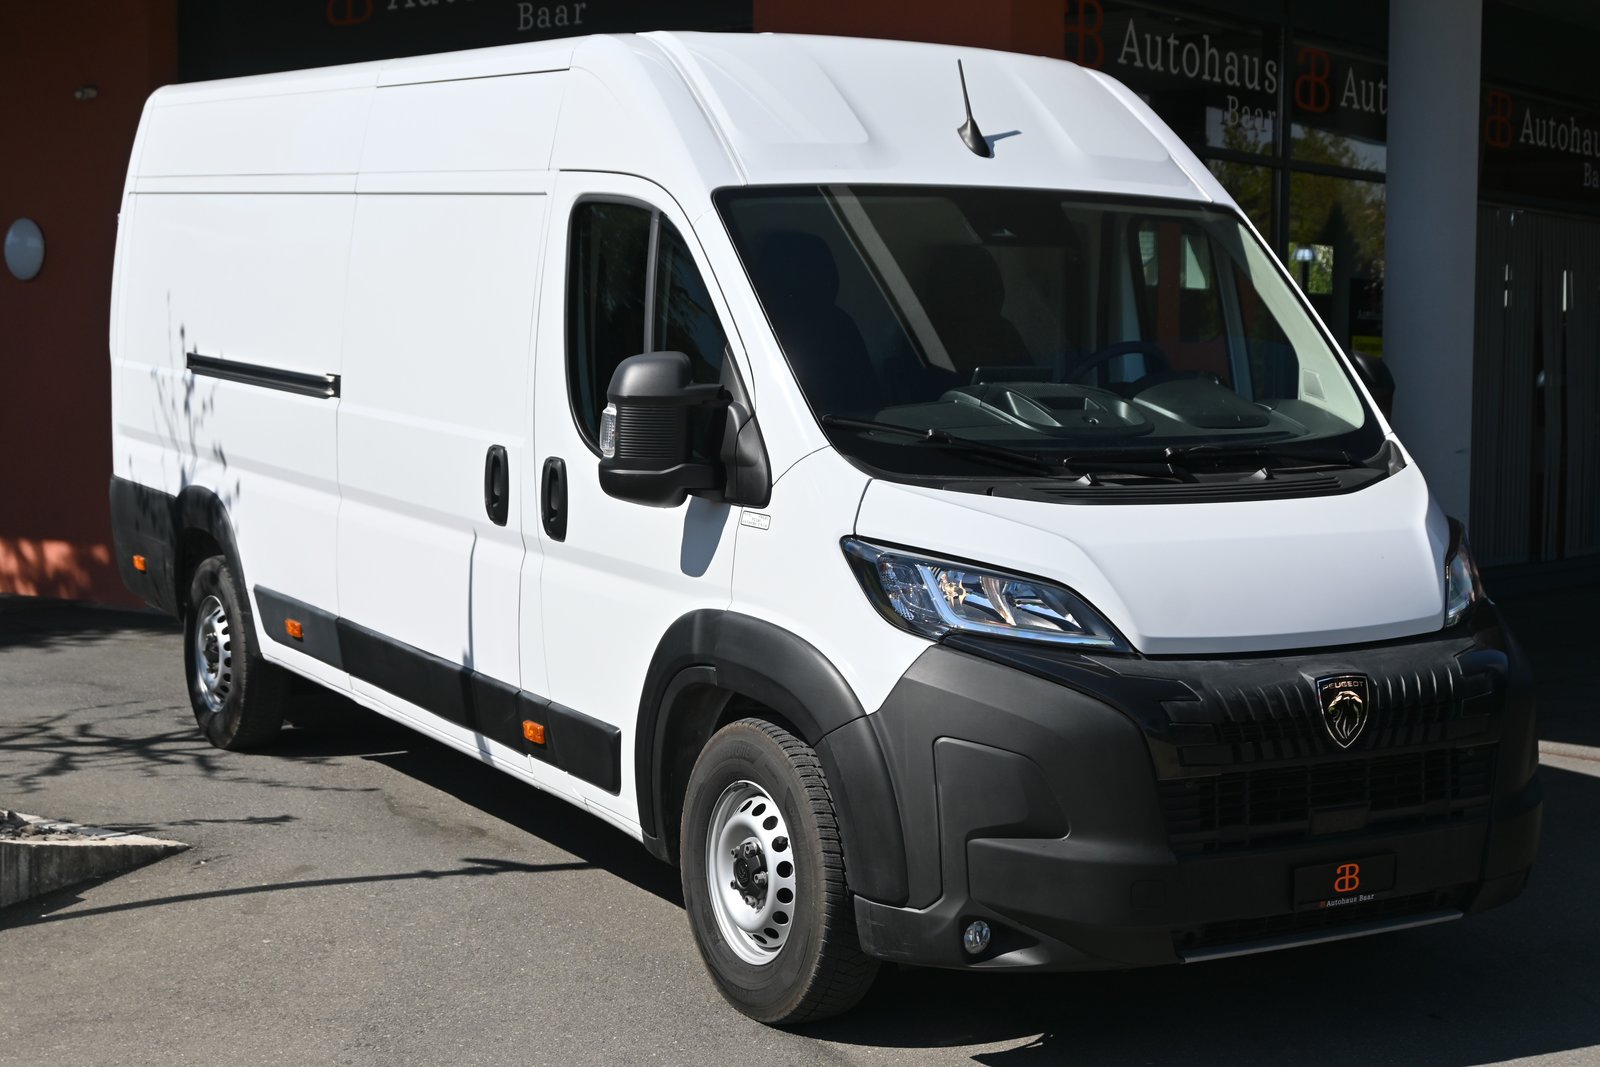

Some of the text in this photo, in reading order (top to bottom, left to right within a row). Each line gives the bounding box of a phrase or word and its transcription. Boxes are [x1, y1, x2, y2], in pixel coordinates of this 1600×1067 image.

[517, 2, 586, 31] Baar
[1117, 18, 1278, 94] Autohaus
[1339, 66, 1388, 115] Aut
[1224, 95, 1277, 131] Baar
[1322, 680, 1364, 690] PEUGEOT
[1326, 897, 1358, 907] Autohaus
